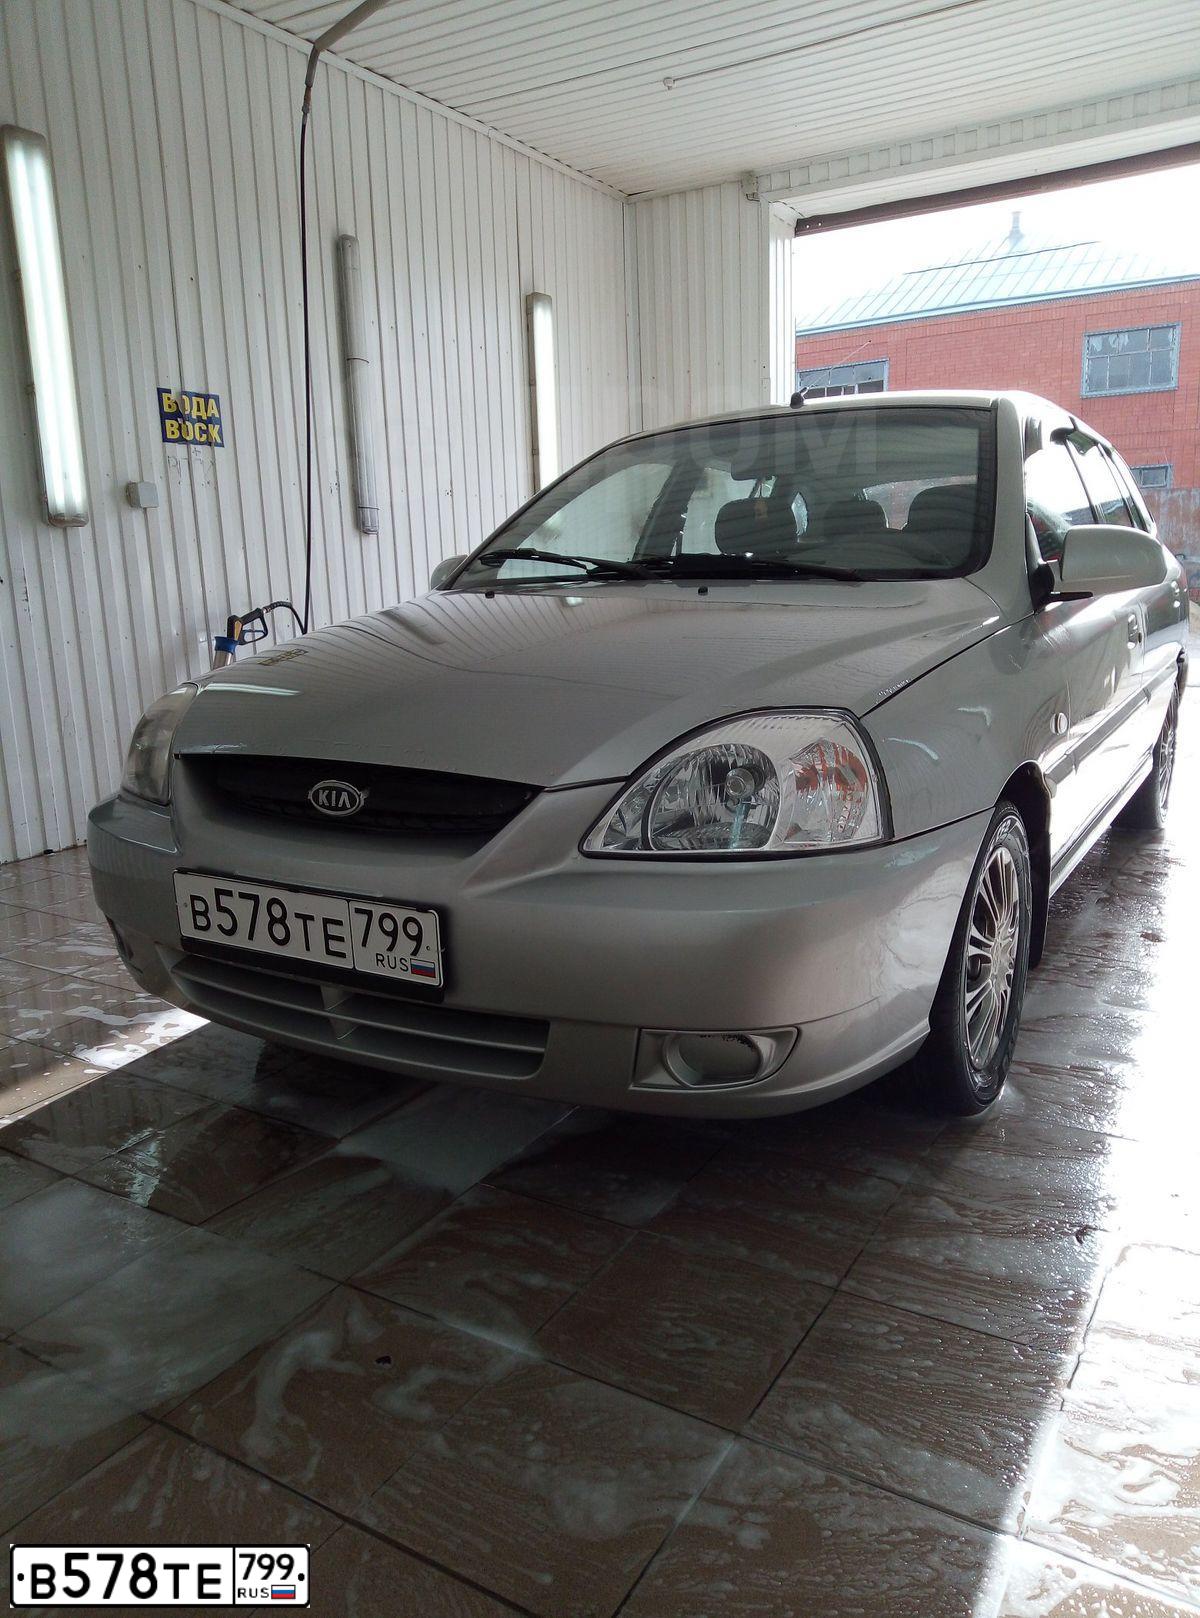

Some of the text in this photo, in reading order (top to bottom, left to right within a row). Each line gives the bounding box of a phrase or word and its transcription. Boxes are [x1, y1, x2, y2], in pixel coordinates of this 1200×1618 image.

[162, 393, 219, 419] ВОДА
[165, 419, 222, 443] ВОСК
[318, 789, 351, 808] KIA
[190, 888, 423, 958] В578ТЕ 799
[375, 953, 408, 971] RUS
